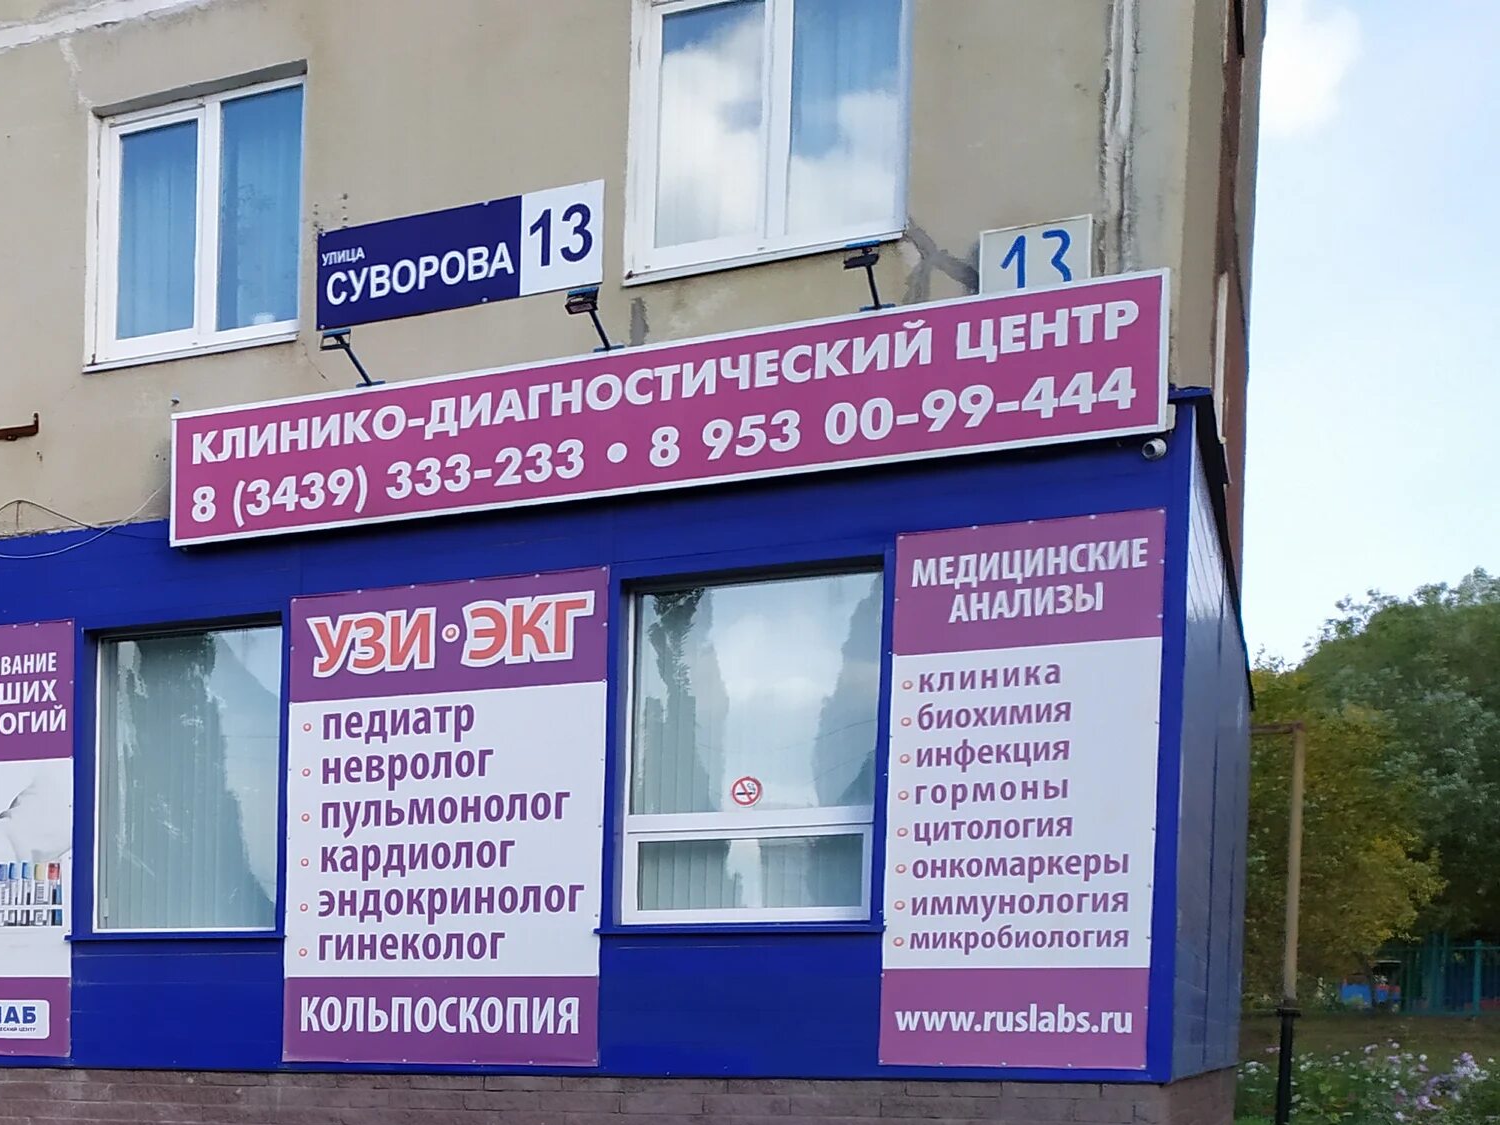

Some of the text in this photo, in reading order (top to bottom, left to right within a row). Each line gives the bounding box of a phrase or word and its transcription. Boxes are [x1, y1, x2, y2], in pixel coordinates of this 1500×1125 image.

[529, 202, 593, 267] 13
[321, 246, 365, 266] УЛИЦА
[326, 242, 515, 306] СУВОРОВА
[1000, 229, 1073, 289] 13
[191, 299, 1140, 465] КЛИНИКО-ДИАГНОСТИЧЕСКИЙ ЦЕНТР
[191, 366, 1138, 527] 8 (3439) 333-233 8 953 00-99-444
[911, 537, 1149, 588] МЕДИЦИНСКИЕ
[949, 582, 1104, 623] АНАЛИЗЫ
[308, 590, 595, 678] УЗИ ЭКГ
[918, 664, 1061, 693] клиника
[322, 704, 474, 744] педиатр
[918, 702, 1071, 731] биохимия
[321, 749, 494, 791] невролог
[916, 739, 1070, 772] инфекция
[914, 777, 1068, 810] гормоны
[321, 792, 570, 838] пульмонолог
[913, 815, 1073, 846] цитология
[320, 840, 515, 882] кардиолог
[912, 851, 1129, 889] онкомаркеры
[317, 884, 584, 925] эндокринолог
[911, 891, 1129, 921] иммунология
[318, 933, 505, 961] гинеколог
[909, 928, 1129, 955] микробиология
[301, 996, 579, 1034] КОЛЬПОСКОПИЯ
[895, 1004, 1132, 1033] www.ruslabs.ru
